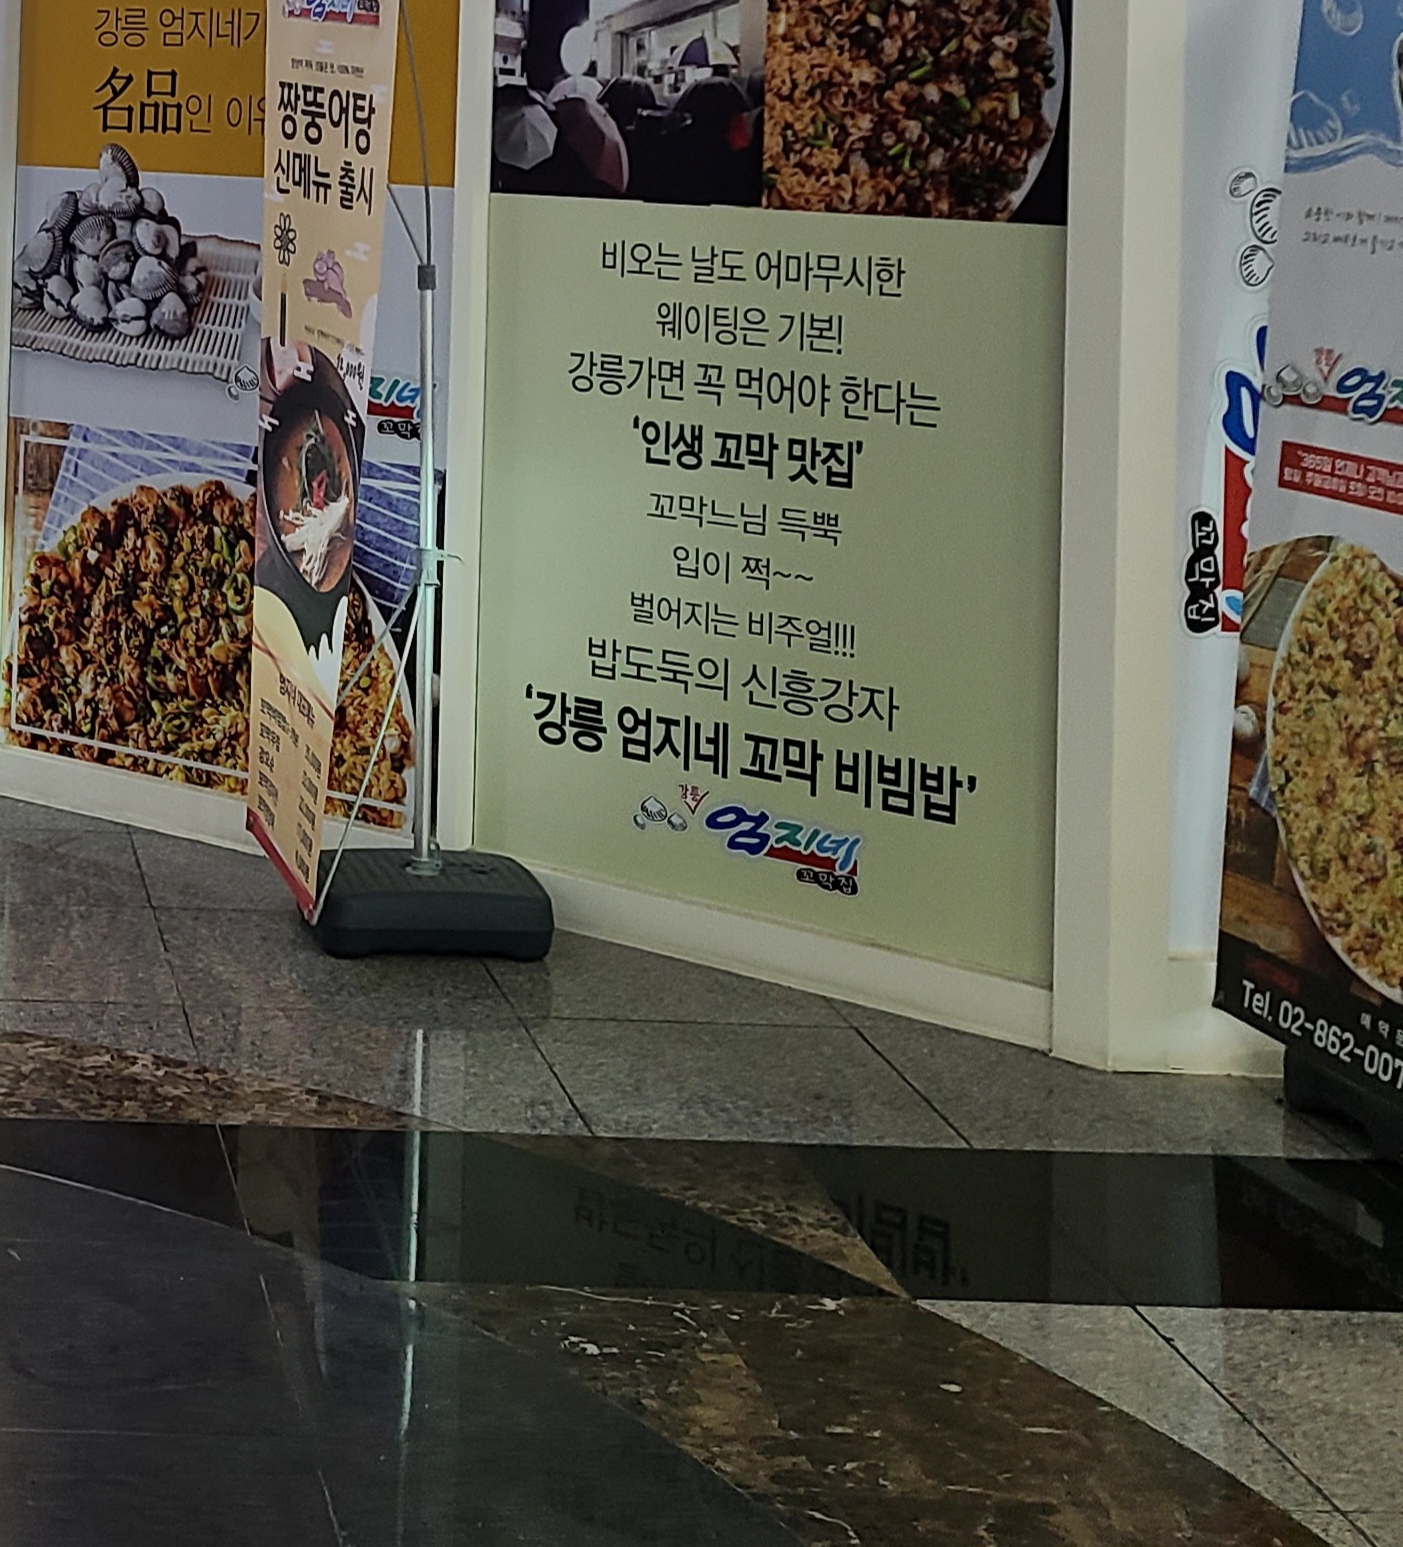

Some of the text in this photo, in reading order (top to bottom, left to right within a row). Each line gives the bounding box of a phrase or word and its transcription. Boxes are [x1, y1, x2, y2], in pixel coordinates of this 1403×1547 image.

[94, 7, 150, 48] 강릉
[92, 65, 212, 135] 名品인
[277, 80, 376, 156] 짱뚱어탕
[273, 147, 374, 217] 신메뉴 출시
[601, 239, 907, 299] 비오는 날도 어마무시한
[655, 301, 844, 356] 웨이팅은 기본!
[567, 350, 942, 429] 강릉가면 꼭 먹어야 한다는
[380, 420, 420, 439] 꼬막
[632, 414, 864, 490] '인생 꼬막 맛집'
[646, 492, 843, 547] 꼬막느님 득뿍
[672, 545, 815, 592] 입이 쩍~~
[1187, 519, 1218, 623] 꼬막집
[628, 591, 856, 659] 벌어지는 비주얼!!!
[586, 635, 901, 733] 밥도둑의 신흥강자
[524, 682, 978, 826] '강릉 엄지네 꼬막 비빔밥'
[679, 782, 704, 802] 강릉
[705, 805, 861, 873] 엄지네
[799, 868, 855, 895] 꼬막집
[1242, 978, 1273, 1023] Tel.
